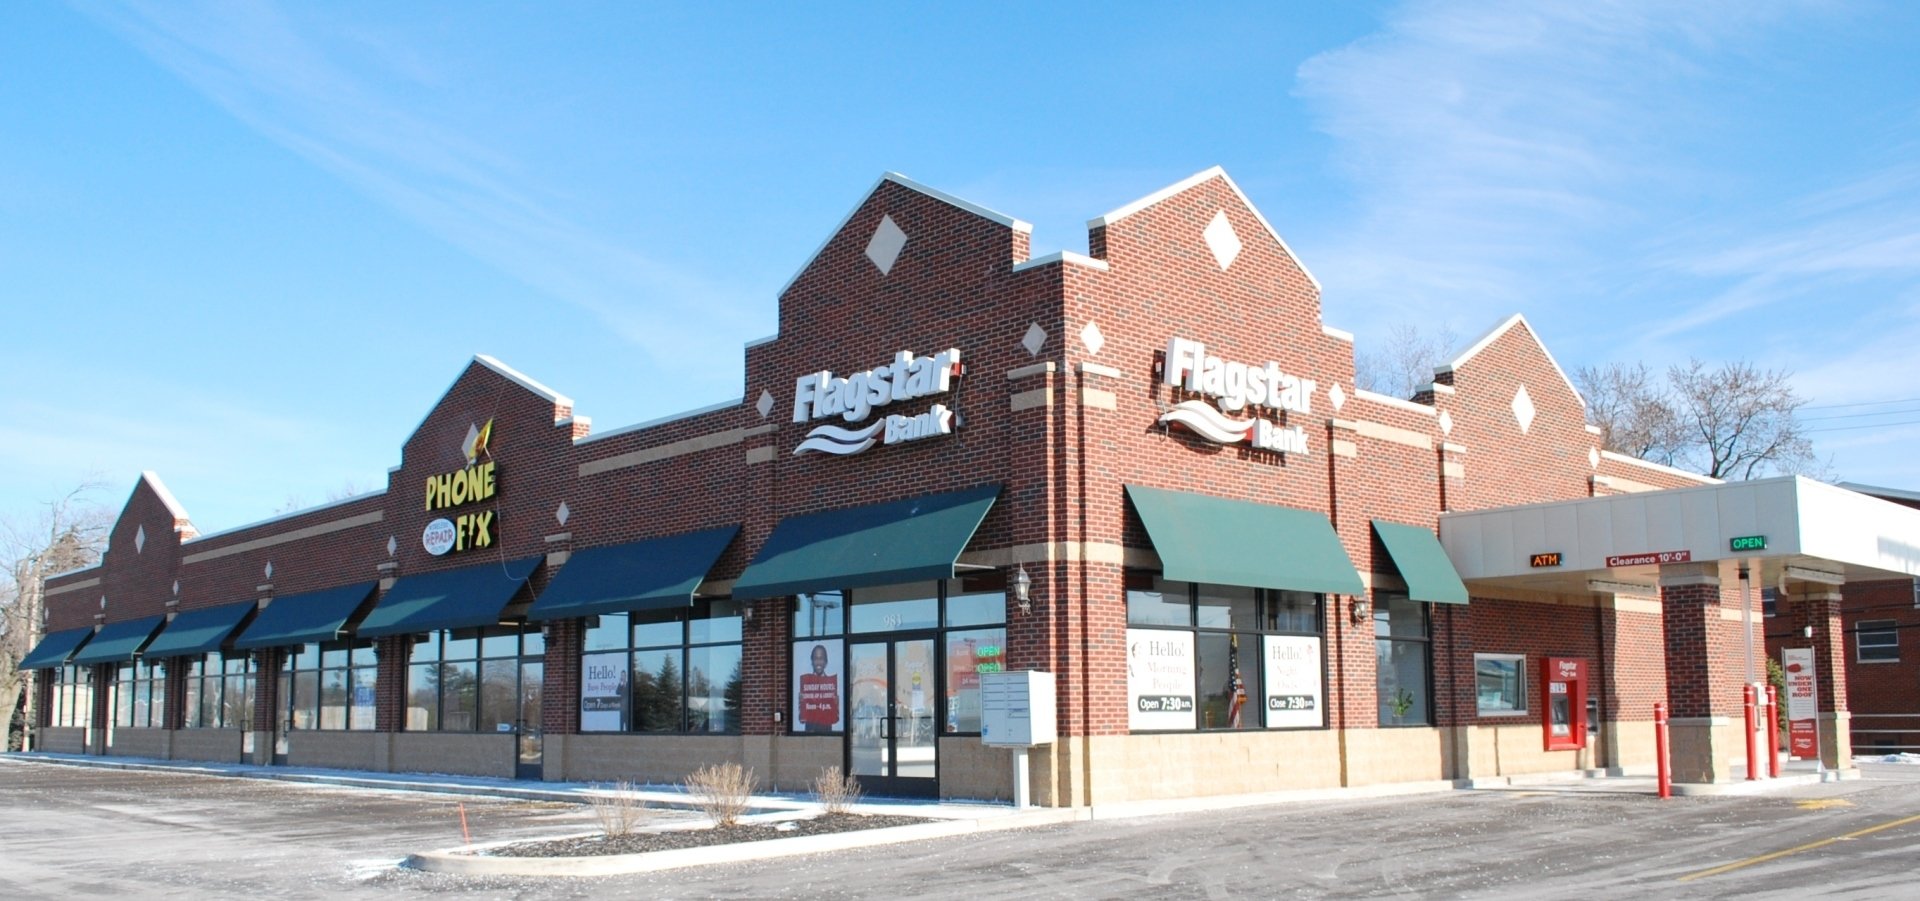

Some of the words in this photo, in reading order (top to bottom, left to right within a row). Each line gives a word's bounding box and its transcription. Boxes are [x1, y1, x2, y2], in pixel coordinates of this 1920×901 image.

[1165, 337, 1316, 414] Flagstar
[793, 348, 959, 423] Flagstar
[884, 404, 953, 445] Bank
[1252, 418, 1309, 454] Bank
[425, 461, 496, 511] PHONE
[425, 528, 453, 545] REPAIR
[1733, 537, 1762, 549] OPEN
[1533, 555, 1558, 566] ATM
[1609, 555, 1656, 567] Clearance
[977, 646, 1000, 657] OPEN
[1149, 641, 1185, 657] Hello!
[1272, 645, 1303, 660] Hello!
[589, 665, 616, 679] Hello!
[596, 698, 601, 709] 7
[1140, 698, 1159, 711] Open
[1161, 697, 1181, 710] 7:30
[1270, 698, 1286, 708] Close
[1287, 697, 1304, 709] 7:30
